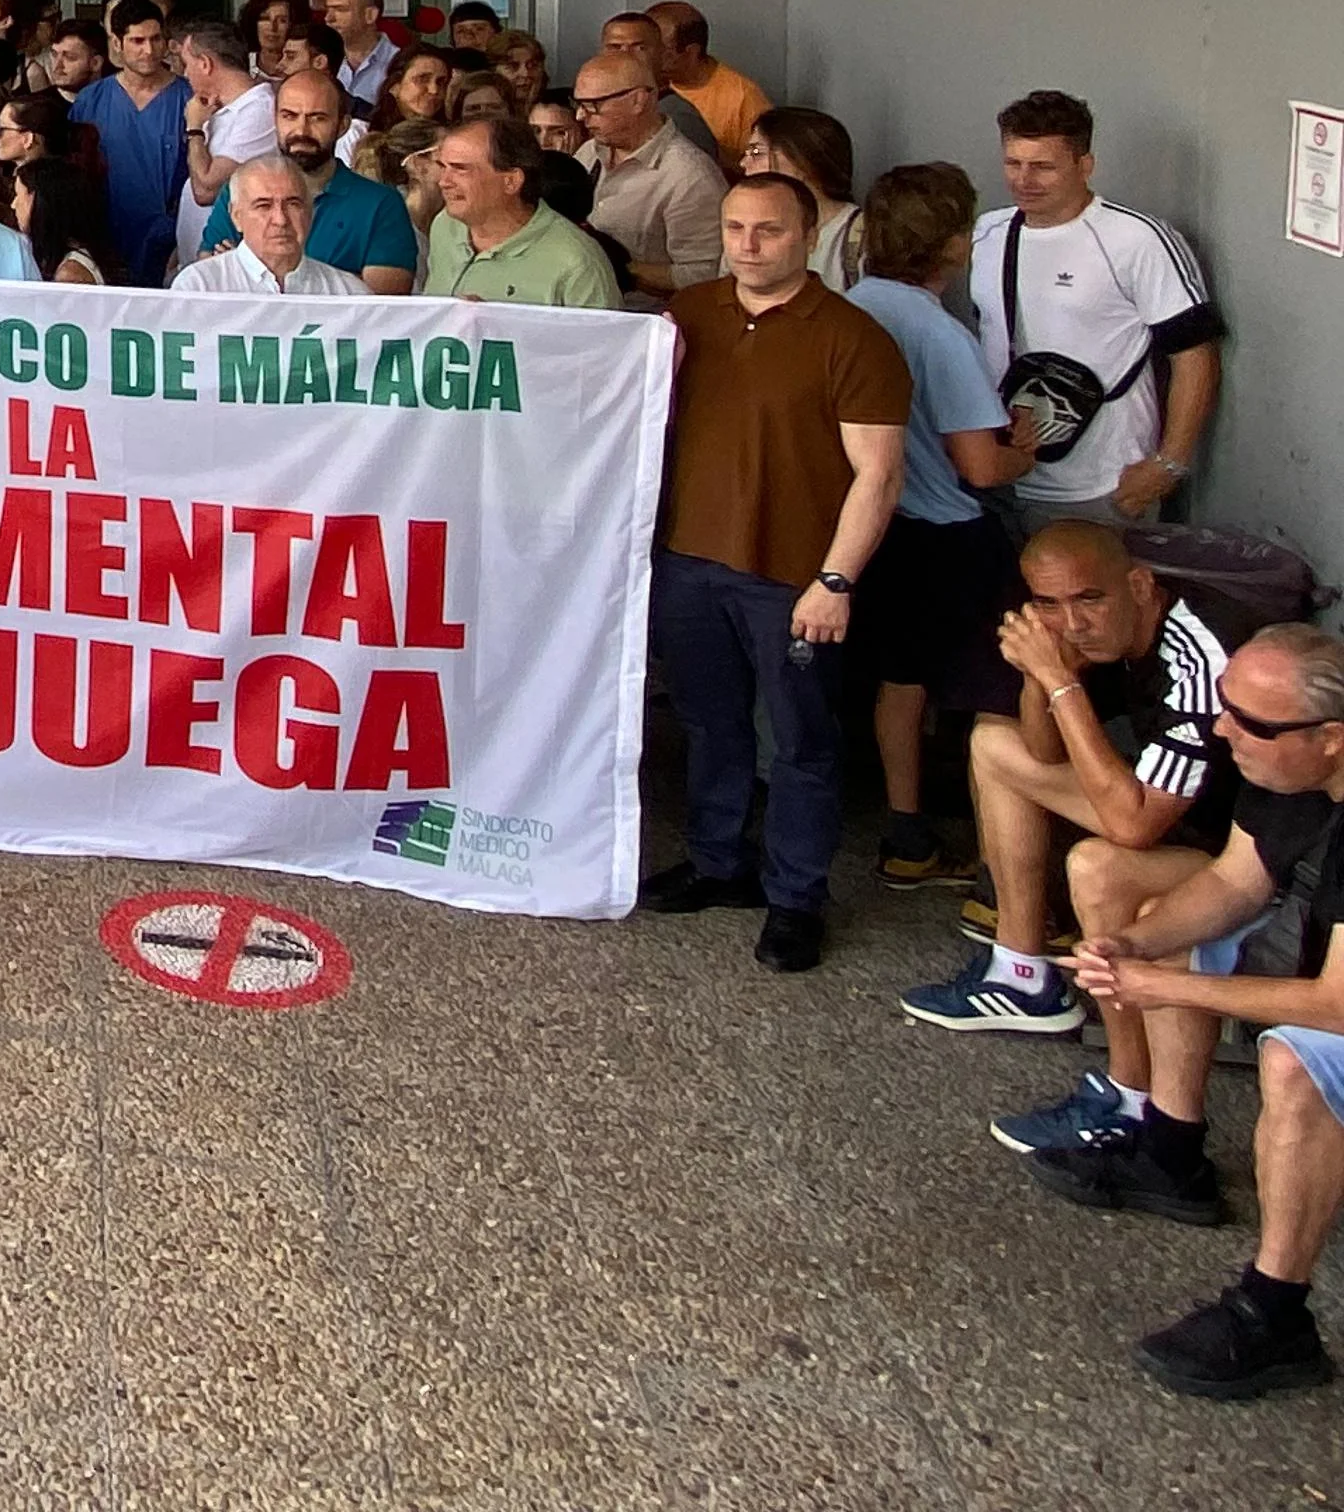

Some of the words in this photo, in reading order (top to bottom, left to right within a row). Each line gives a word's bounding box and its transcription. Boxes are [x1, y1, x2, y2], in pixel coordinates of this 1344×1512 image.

[110, 327, 198, 401] DE
[218, 323, 522, 413] MÁLAGA
[7, 396, 98, 481] LA
[462, 806, 554, 844] SINDICATO
[460, 829, 530, 862] MÉDICO
[456, 852, 534, 888] MÁLAGA
